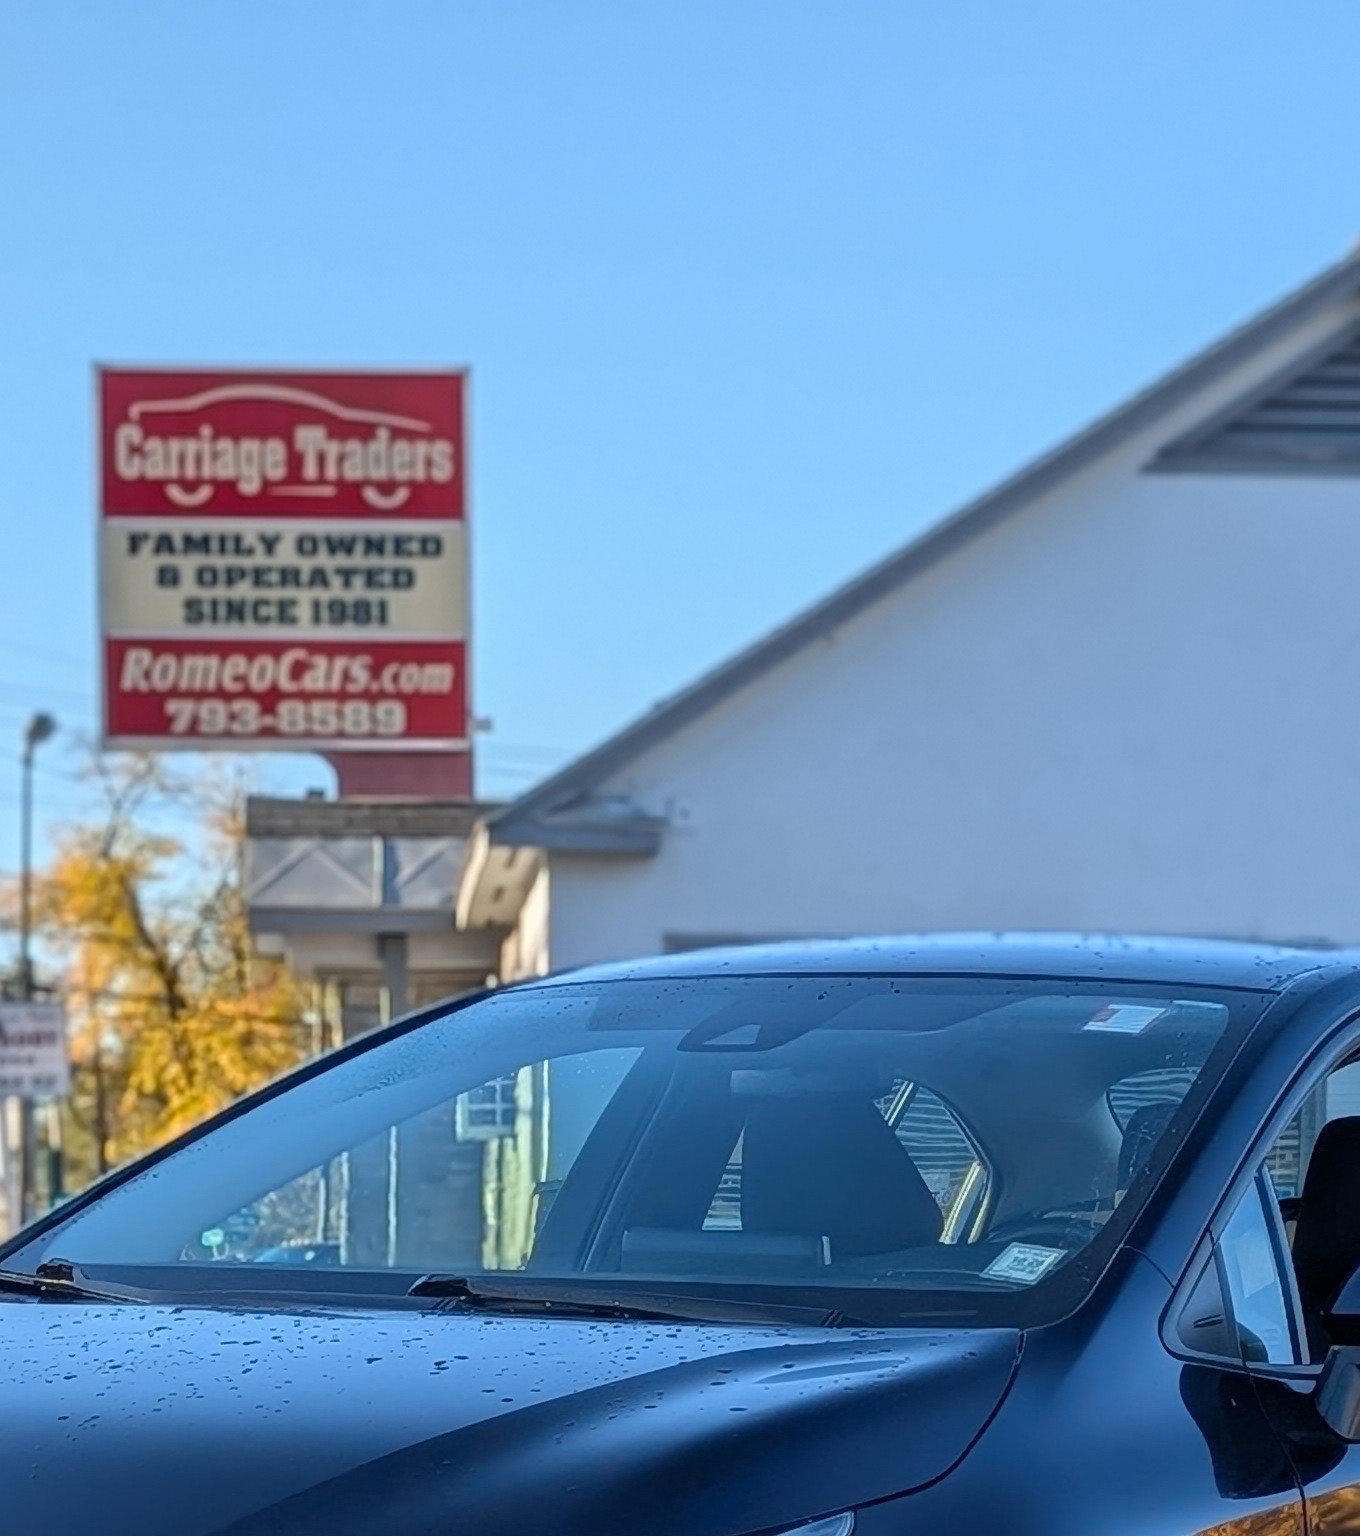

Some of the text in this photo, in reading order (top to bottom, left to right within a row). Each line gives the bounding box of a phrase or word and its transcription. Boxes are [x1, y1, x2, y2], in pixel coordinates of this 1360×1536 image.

[115, 423, 454, 496] Carriage Traders
[128, 533, 443, 558] FAMILY OWNED
[196, 566, 415, 590] OPERATED
[183, 597, 389, 626] SINCE 1981
[121, 649, 454, 693] RomeoCars.com
